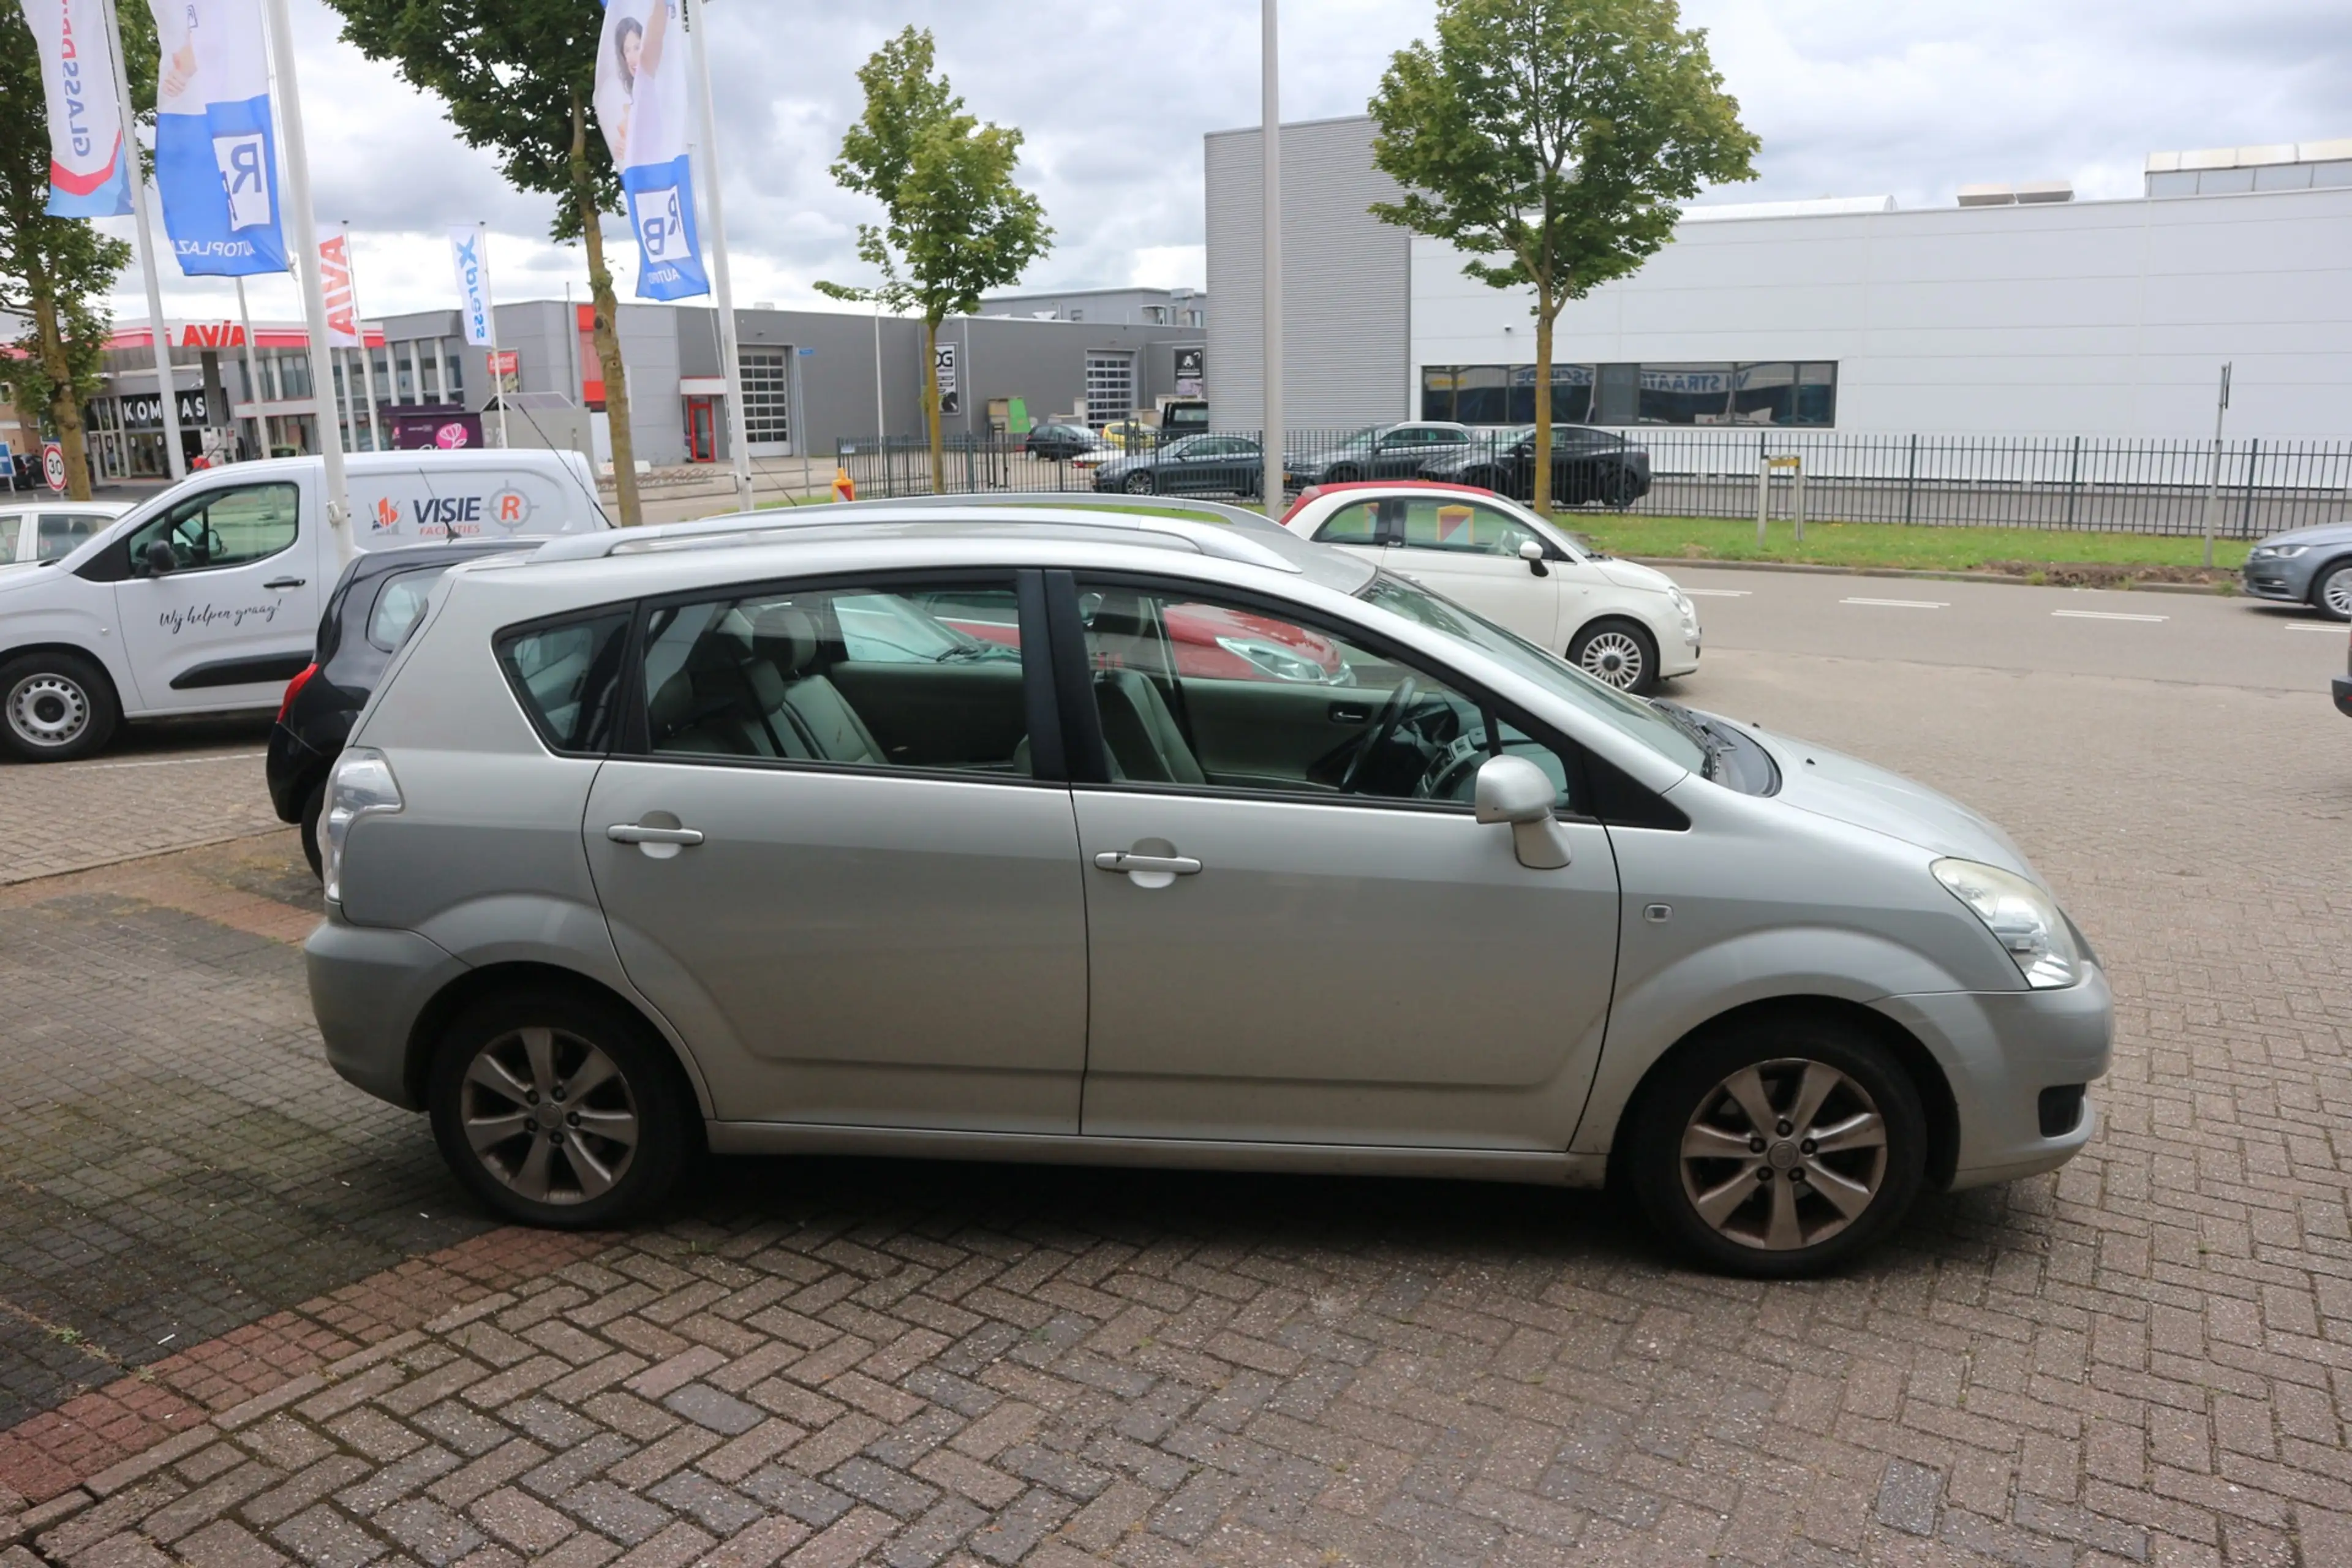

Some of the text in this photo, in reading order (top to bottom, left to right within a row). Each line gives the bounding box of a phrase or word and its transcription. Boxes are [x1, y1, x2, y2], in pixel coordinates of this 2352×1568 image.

[183, 320, 246, 347] AVIA
[124, 397, 205, 421] KOMAS
[48, 459, 63, 475] 30
[413, 495, 521, 524] VISIE R
[160, 598, 281, 635] Wij helpen graag!
